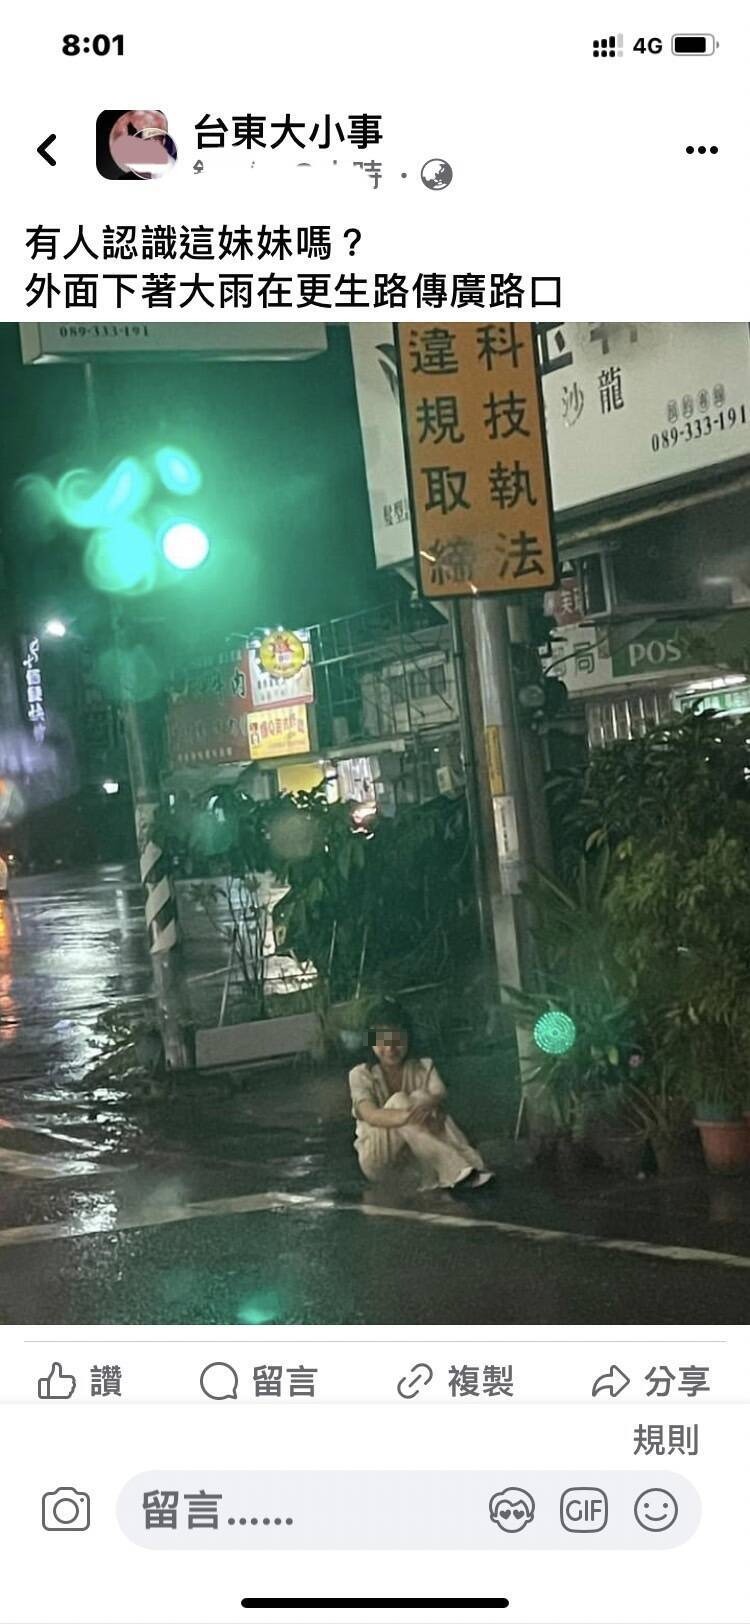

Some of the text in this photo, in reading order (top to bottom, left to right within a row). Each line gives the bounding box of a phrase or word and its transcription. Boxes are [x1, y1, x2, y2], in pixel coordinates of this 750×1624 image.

[62, 34, 124, 56] 8:01
[633, 38, 663, 54] 4G
[195, 113, 383, 149] 台東大小事
[25, 224, 362, 260] 有人認識這妹妹嗎？
[25, 272, 561, 308] 外面下著大雨在更生路傳廣路口
[59, 325, 150, 338] 089-333-191
[562, 367, 625, 426] 沙龍
[651, 404, 747, 453] 089-333-191
[476, 323, 545, 580] 科技執法
[90, 1365, 122, 1397] 讚
[253, 1365, 318, 1397] 留言
[448, 1365, 514, 1397] 複製
[645, 1365, 711, 1397] 分享
[634, 1424, 699, 1455] 規則
[566, 1499, 602, 1522] GIF
